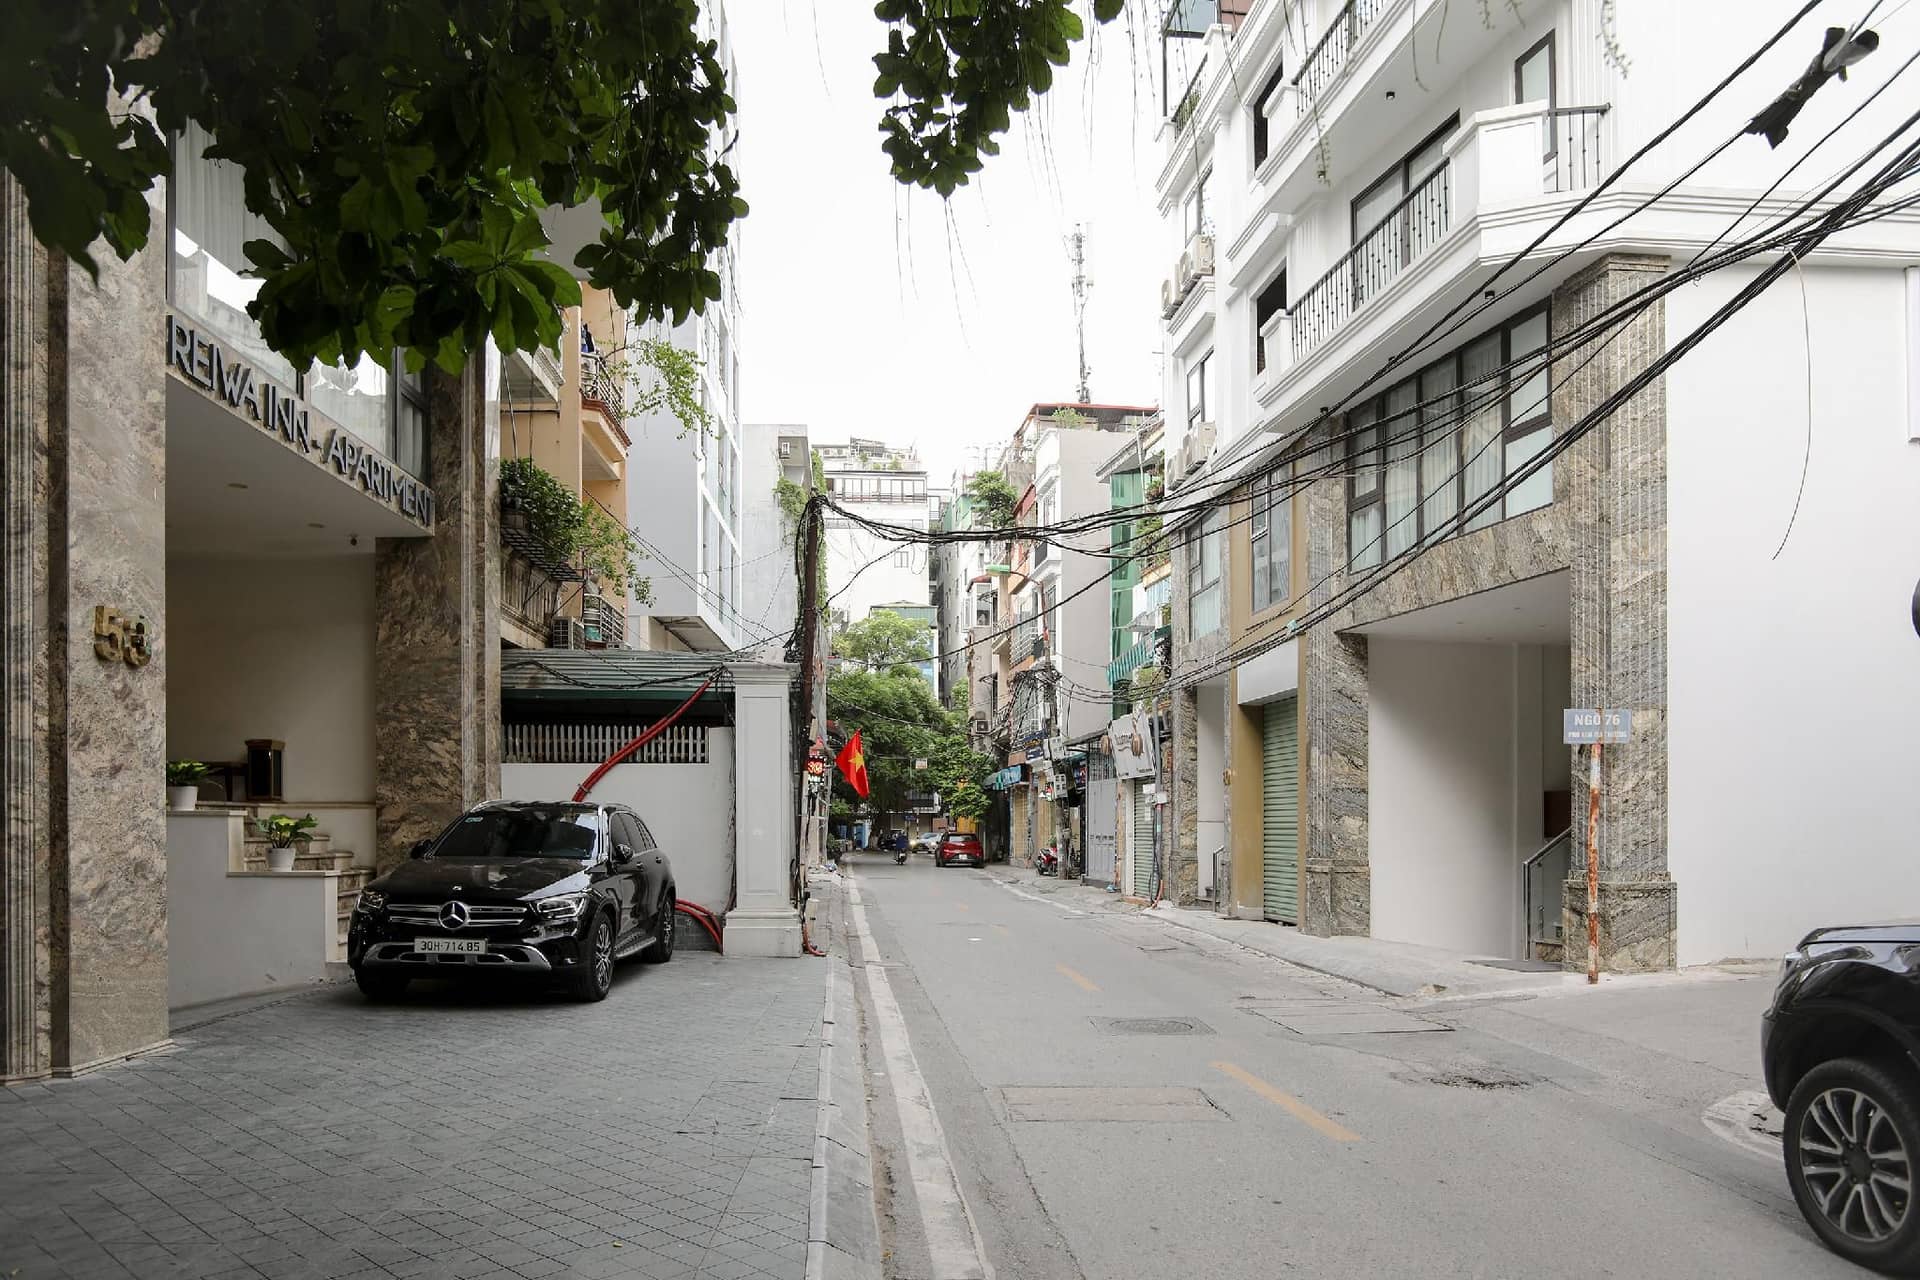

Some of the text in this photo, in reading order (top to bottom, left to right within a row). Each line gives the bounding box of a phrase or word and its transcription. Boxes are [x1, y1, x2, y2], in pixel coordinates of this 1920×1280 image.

[167, 315, 261, 421] REIWA
[263, 383, 310, 454] INN
[323, 429, 434, 528] APARTMENT
[1605, 714, 1621, 726] 76
